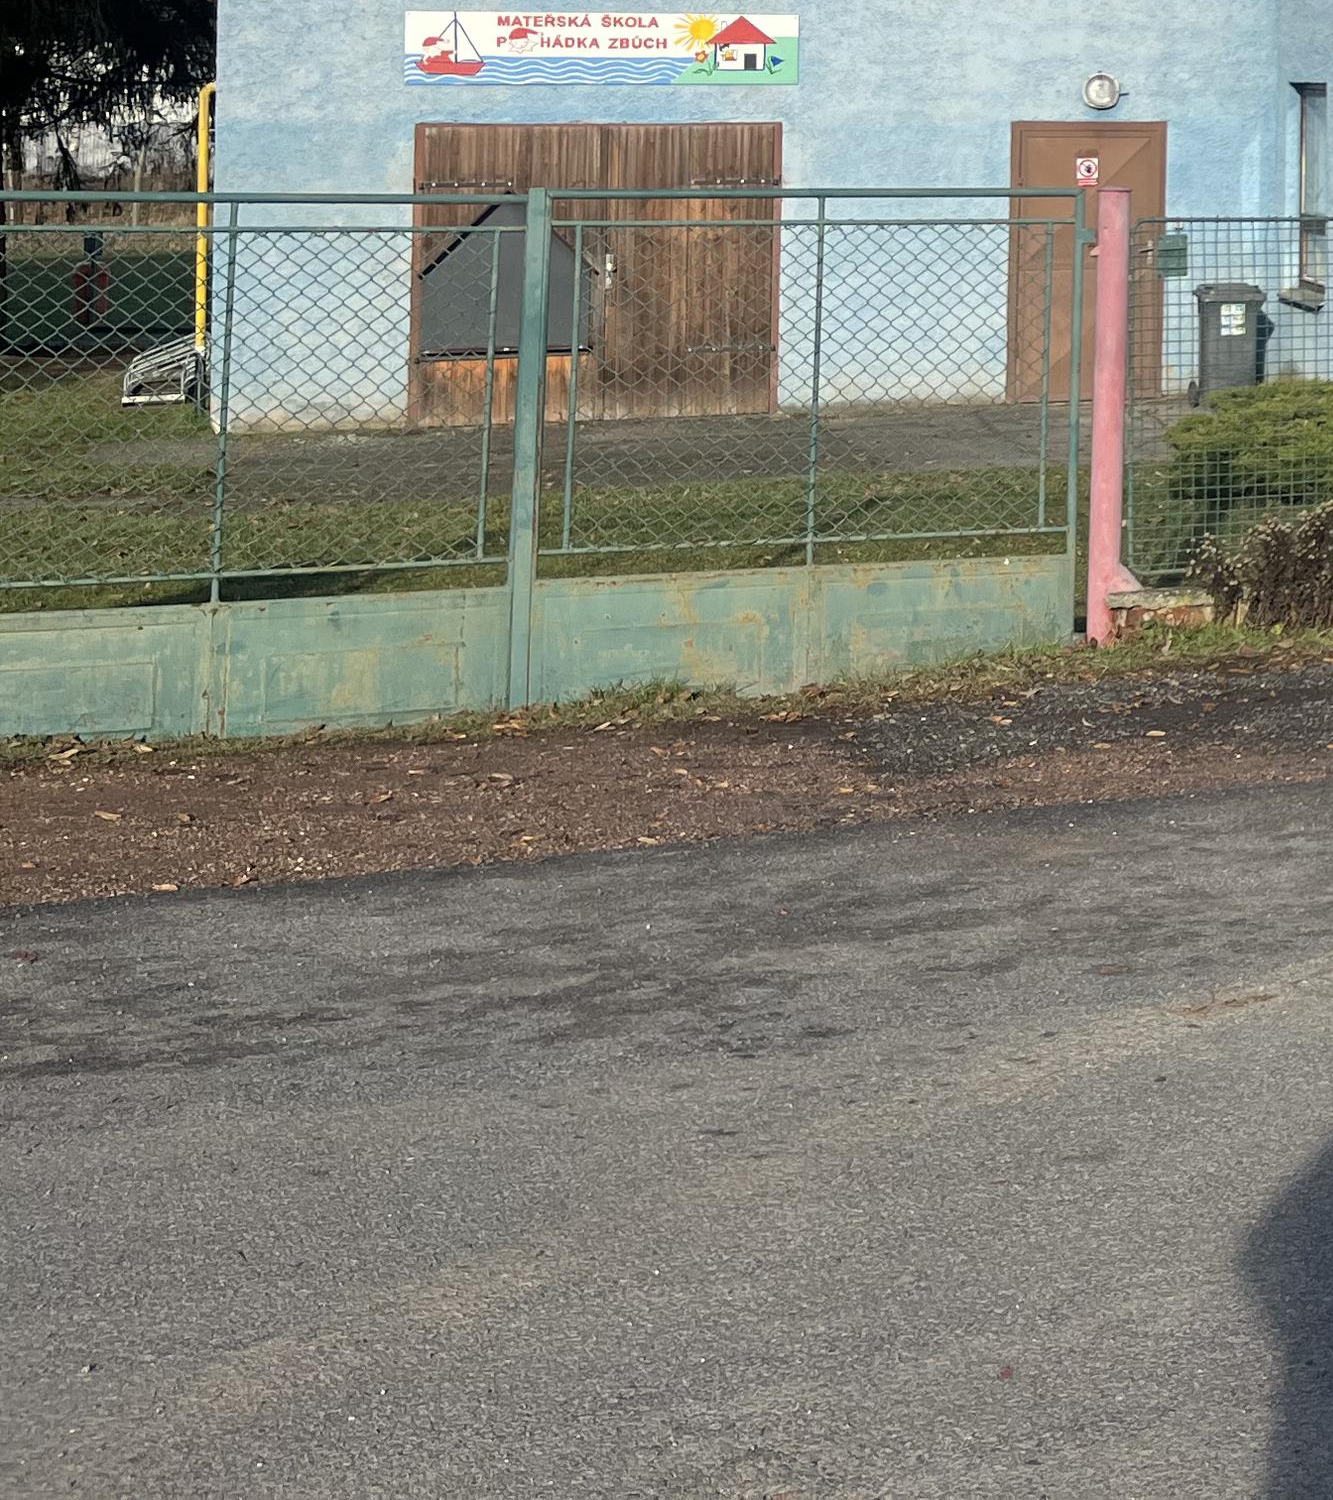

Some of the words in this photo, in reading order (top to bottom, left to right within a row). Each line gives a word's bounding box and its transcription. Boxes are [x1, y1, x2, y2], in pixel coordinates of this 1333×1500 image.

[497, 14, 592, 28] MATEŘSKÁ
[601, 14, 660, 28] ŠKOLA
[496, 32, 600, 49] PHÁDKA
